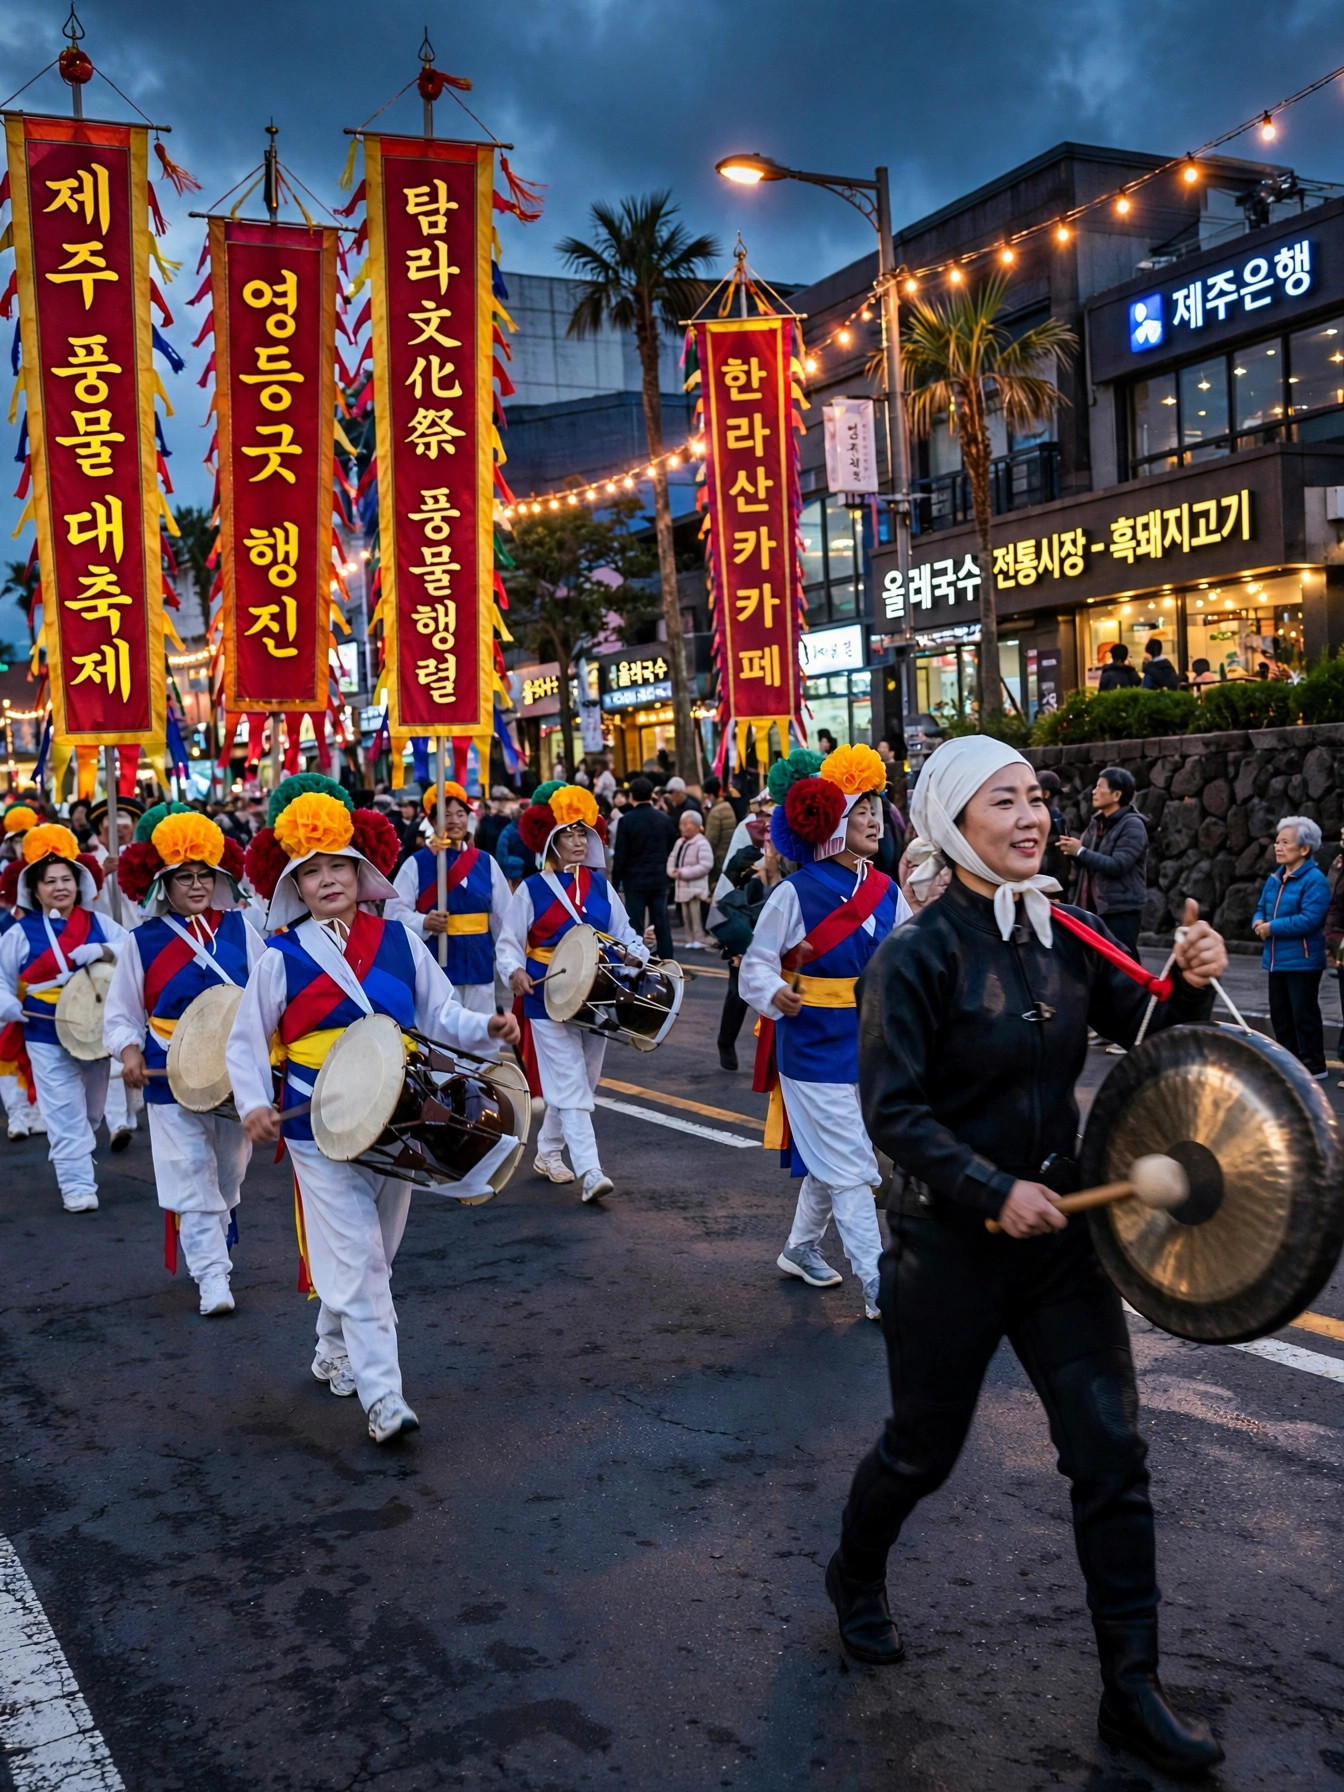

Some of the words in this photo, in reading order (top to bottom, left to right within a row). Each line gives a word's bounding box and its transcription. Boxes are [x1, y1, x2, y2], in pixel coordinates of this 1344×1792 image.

[42, 163, 118, 310] 제주
[403, 178, 466, 460] 탐라文化祭
[1172, 239, 1311, 329] 제주은행
[50, 334, 125, 477] 풍물
[238, 269, 305, 484] 영등굿
[63, 494, 133, 703] 대축제
[242, 522, 300, 658] 행진
[407, 487, 461, 704] 풍물행렬
[720, 356, 781, 688] 한라산카카페
[881, 553, 982, 619] 올레국수
[992, 527, 1086, 590] 전통시장
[1109, 489, 1250, 564] 흑돼지고기
